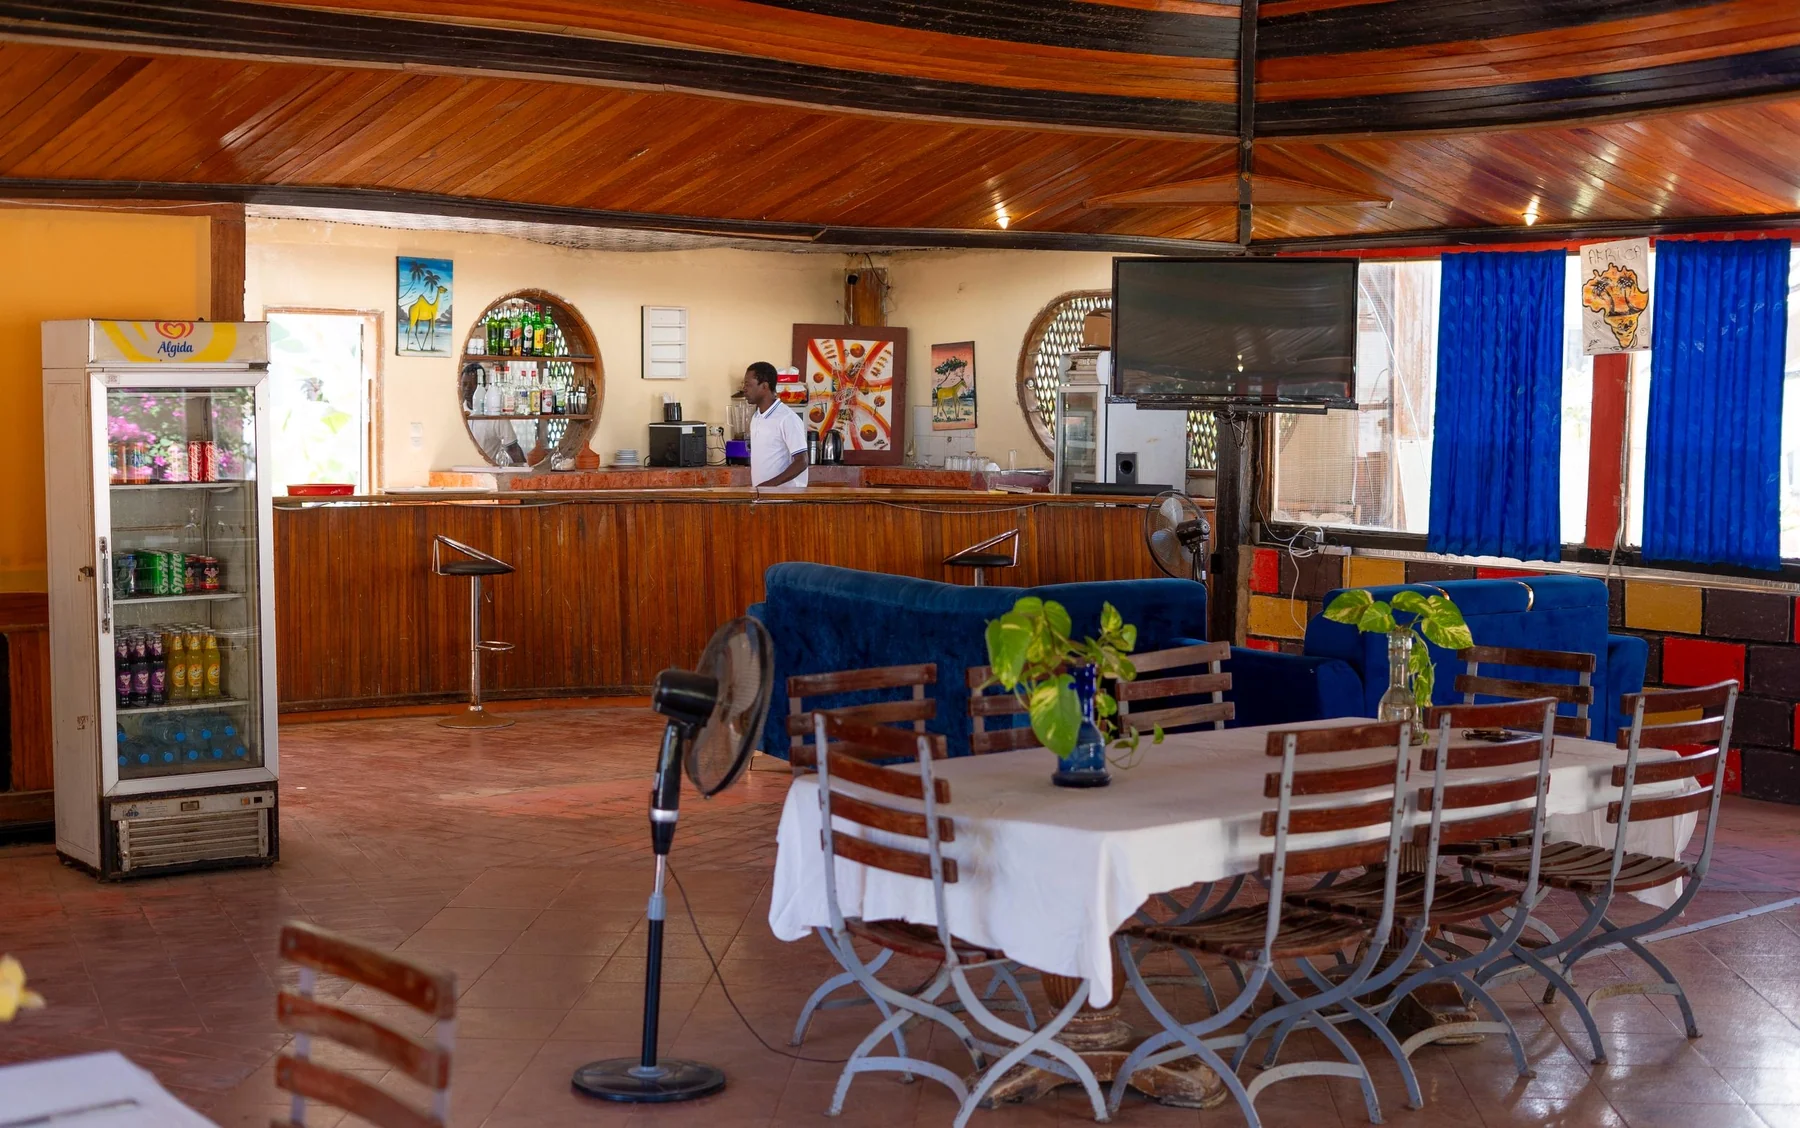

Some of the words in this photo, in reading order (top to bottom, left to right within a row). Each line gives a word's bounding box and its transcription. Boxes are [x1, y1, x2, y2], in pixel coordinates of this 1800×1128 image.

[157, 340, 194, 358] Algida
[160, 553, 169, 594] Sprite
[171, 553, 183, 594] Sprite
